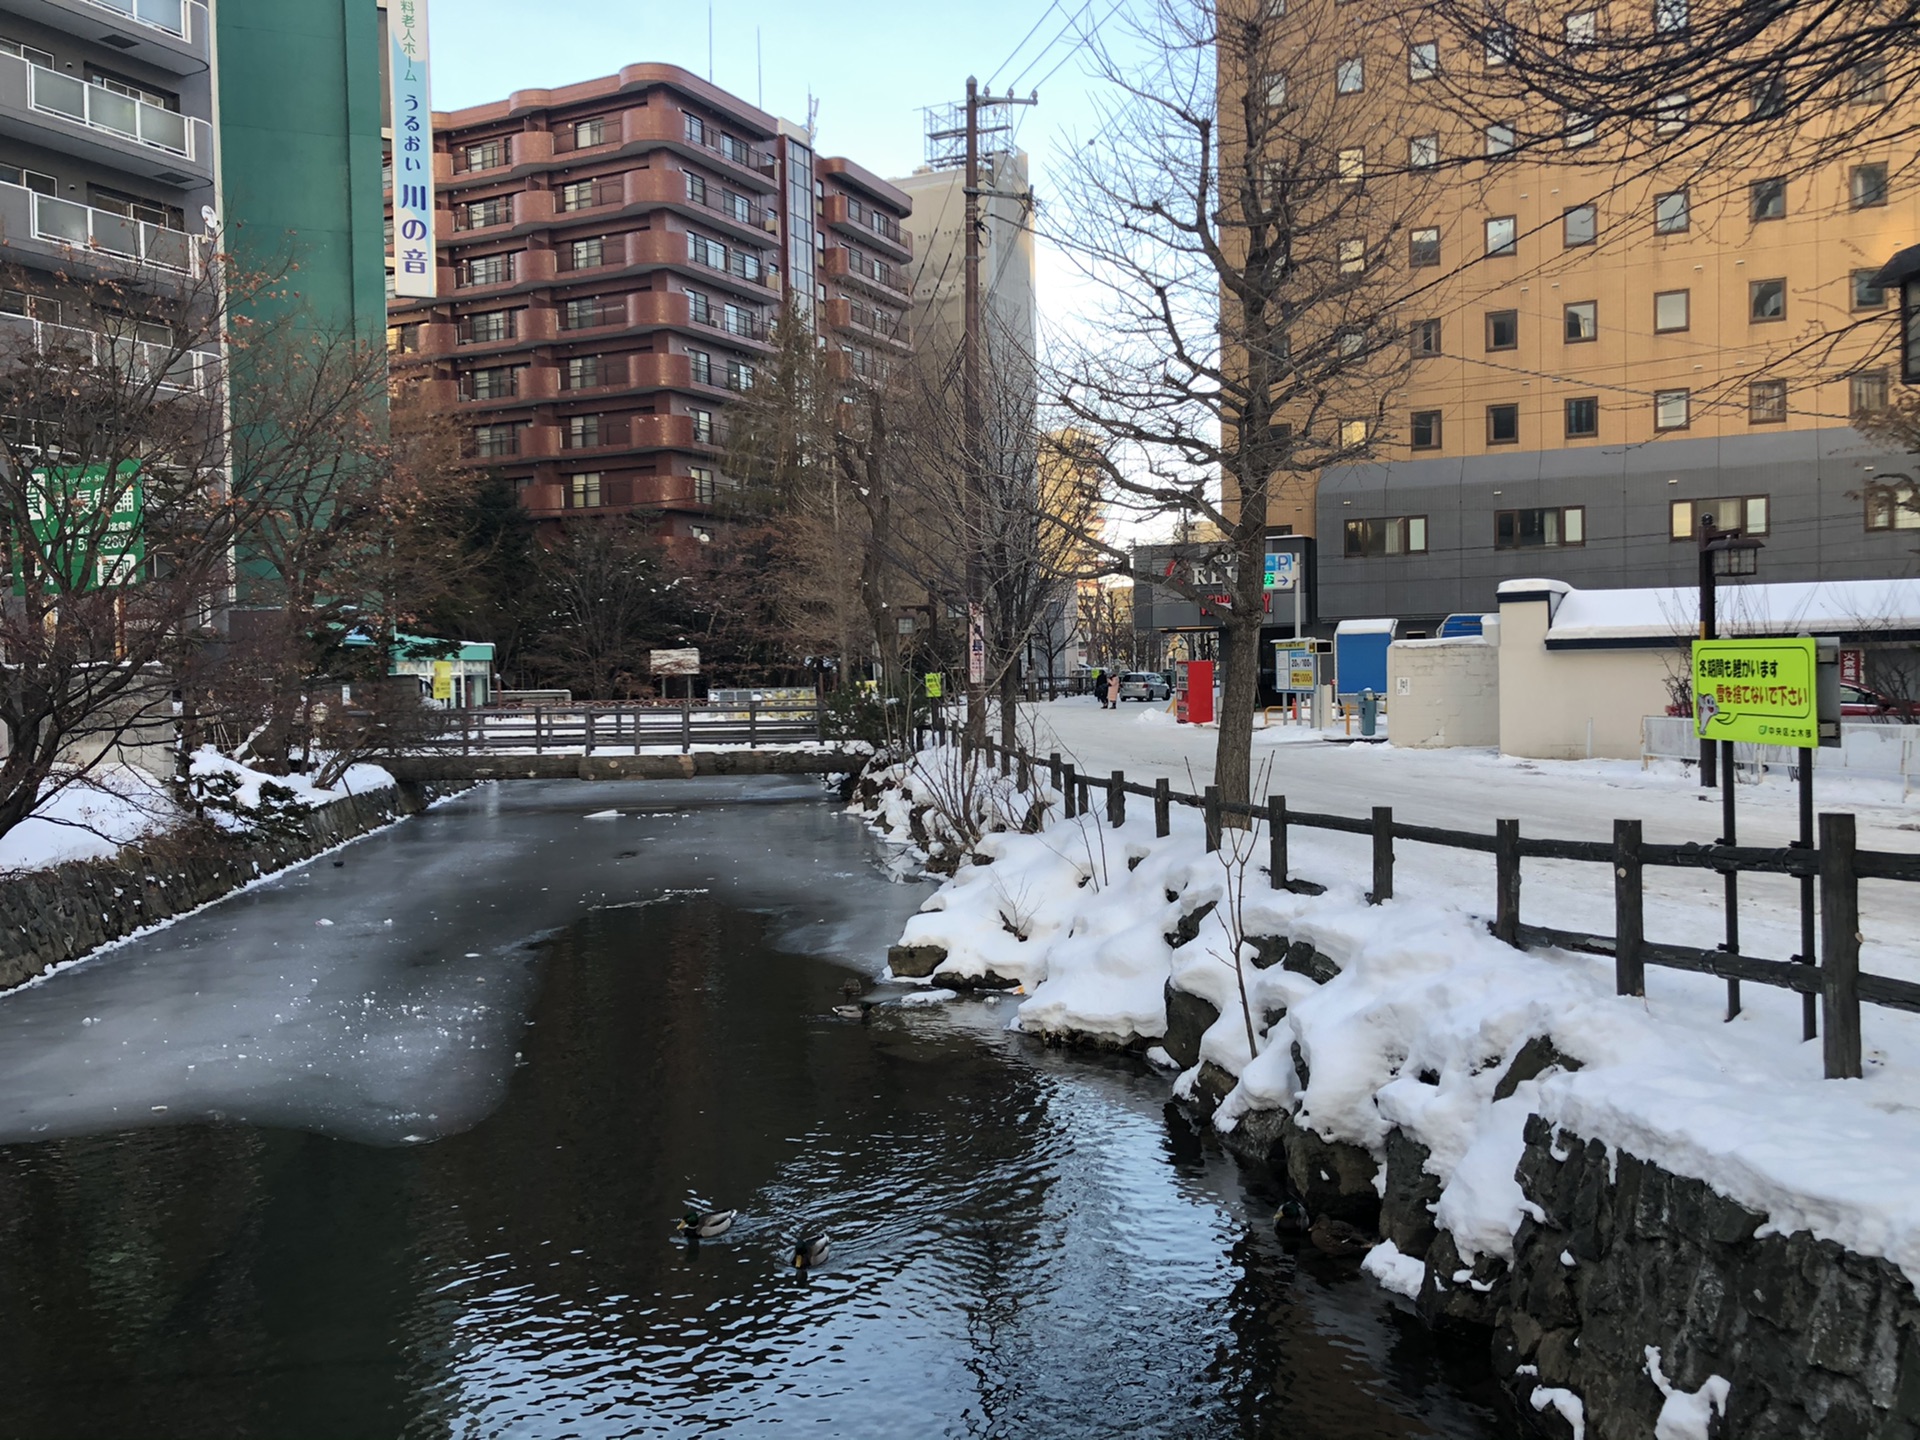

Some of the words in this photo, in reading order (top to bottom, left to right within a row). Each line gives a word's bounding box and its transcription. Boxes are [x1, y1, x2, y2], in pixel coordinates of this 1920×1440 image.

[402, 94, 421, 172] うるおい
[401, 184, 429, 275] 川の音
[1698, 658, 1779, 679] 冬期間も鯉がいます
[1715, 684, 1807, 707] 雪を捨てないで下さい
